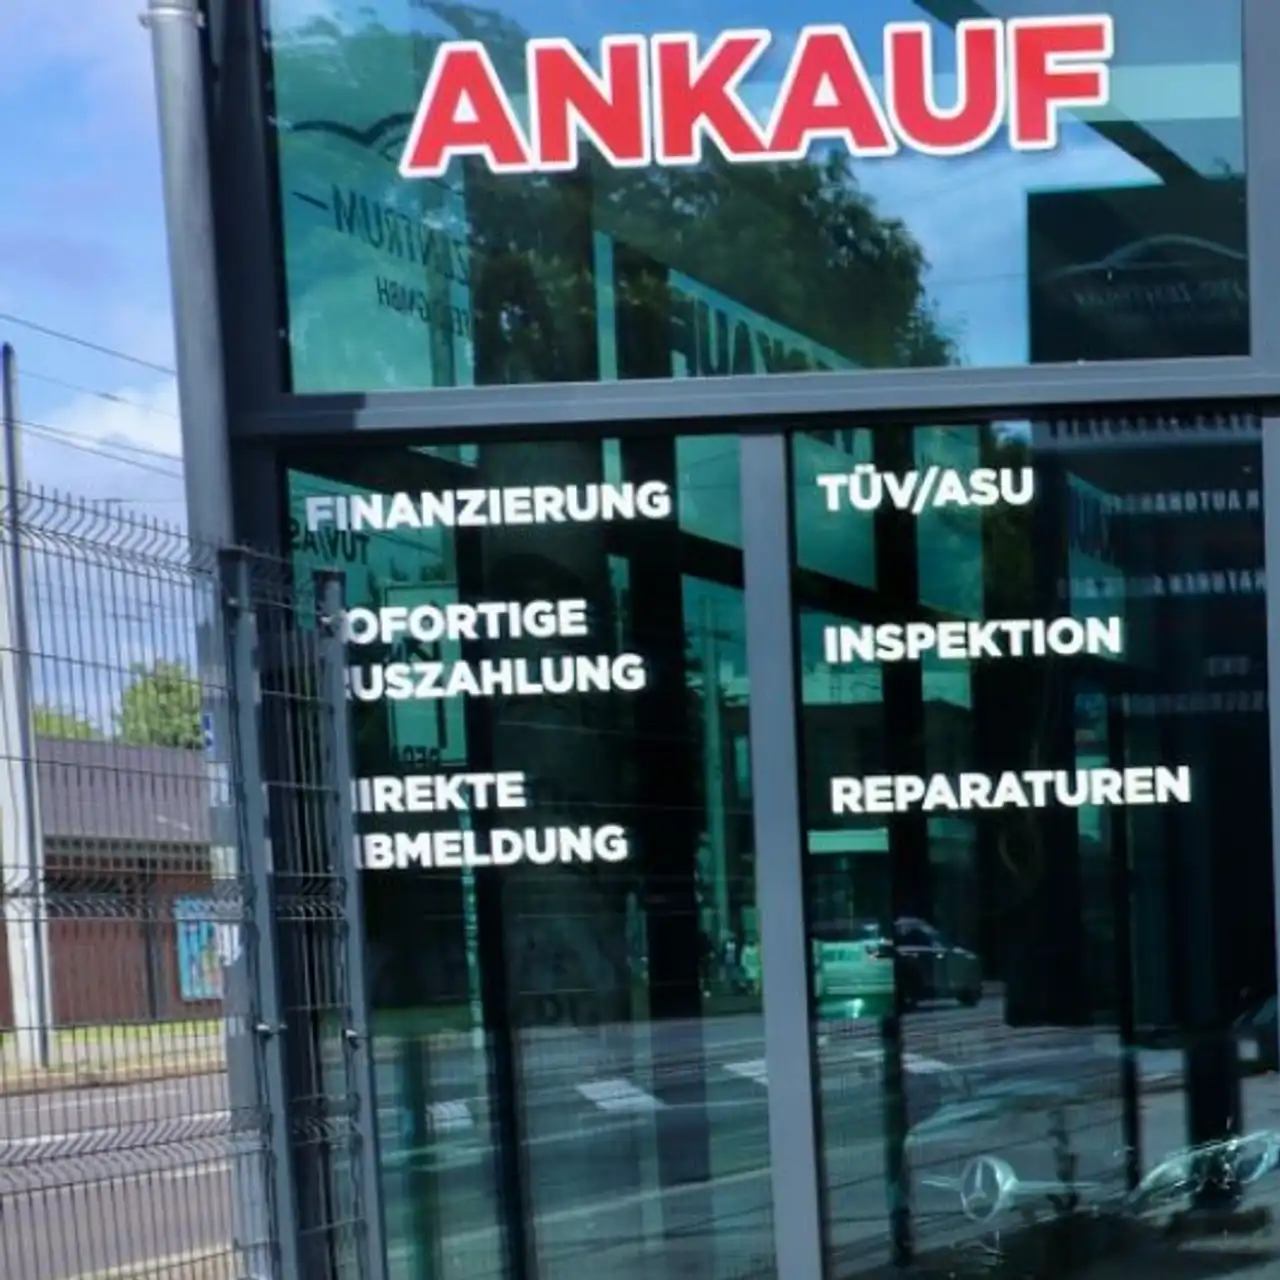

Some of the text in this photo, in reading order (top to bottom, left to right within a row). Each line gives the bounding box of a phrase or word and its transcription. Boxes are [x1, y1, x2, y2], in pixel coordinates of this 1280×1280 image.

[400, 15, 1113, 178] ANKAUF
[305, 480, 672, 532] FINANZIERUNG
[817, 464, 1034, 514] TÜV/ASU
[343, 599, 588, 645] OFORTIGE
[823, 616, 1122, 663] INSPEKTION
[344, 653, 646, 702] USZAHLUNG
[350, 771, 528, 814] IREKTE
[831, 765, 1192, 814] REPARATUREN
[353, 825, 629, 870] BMELDUNG
